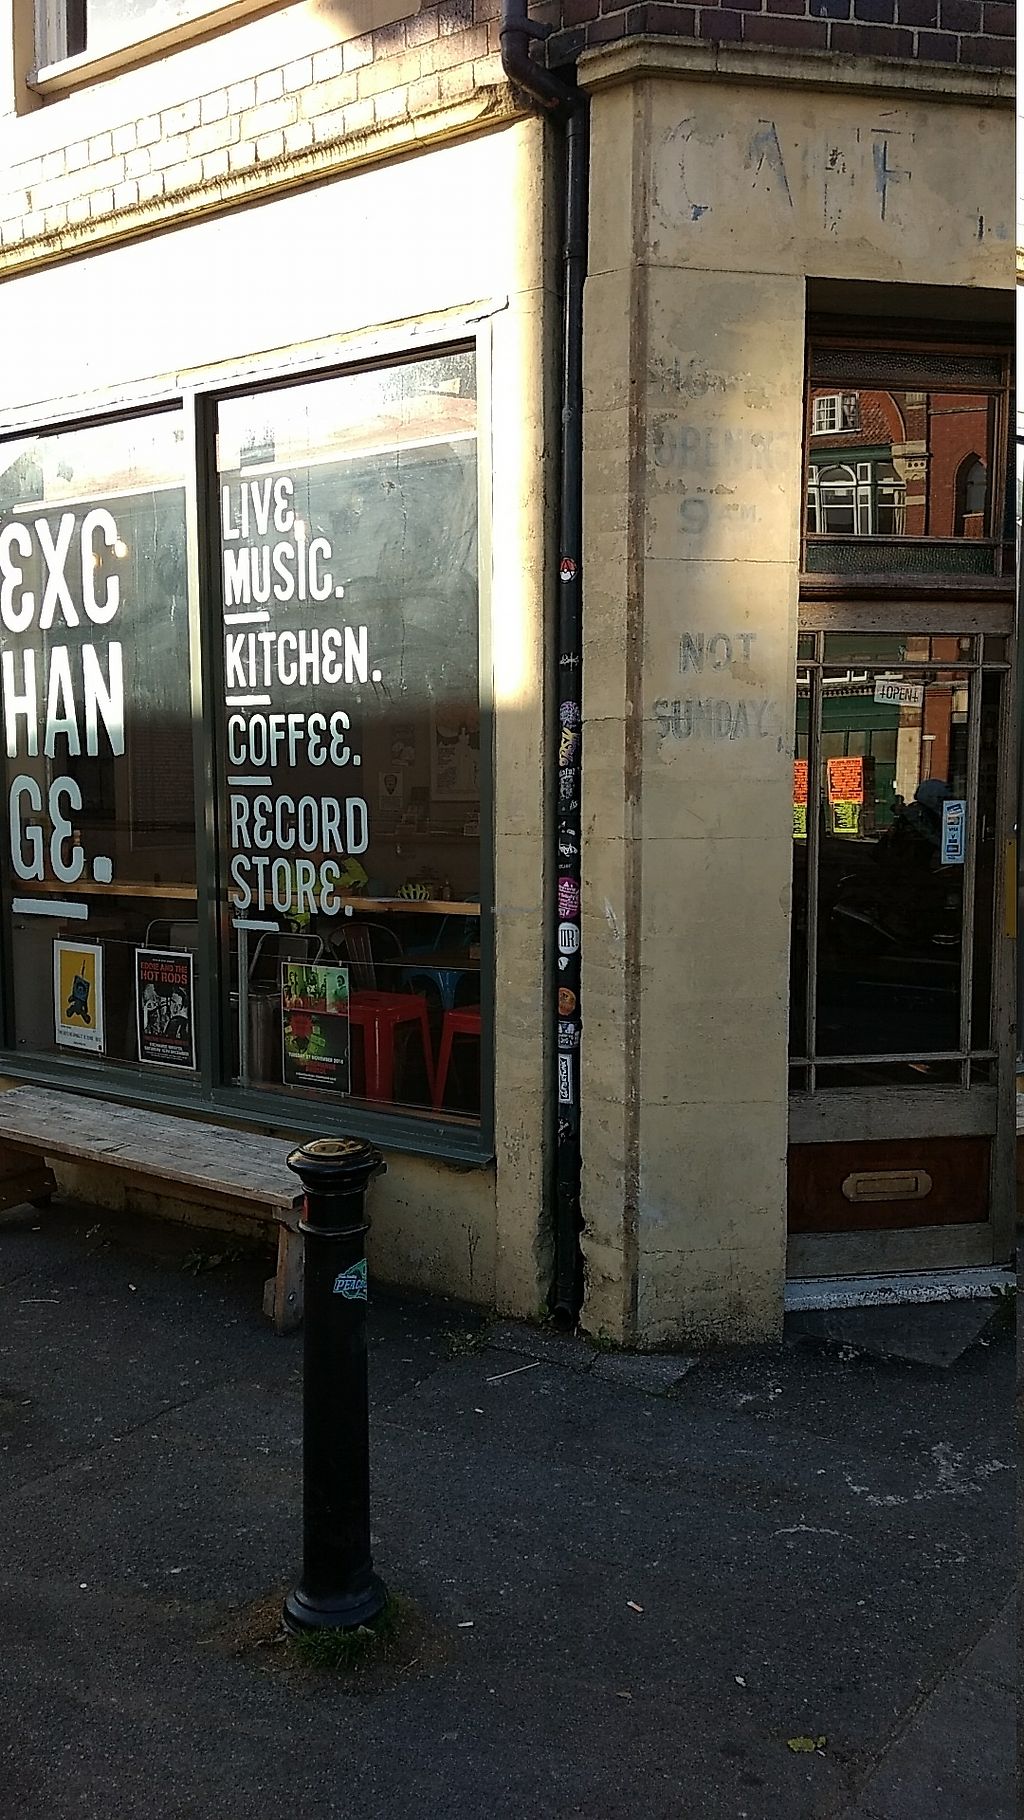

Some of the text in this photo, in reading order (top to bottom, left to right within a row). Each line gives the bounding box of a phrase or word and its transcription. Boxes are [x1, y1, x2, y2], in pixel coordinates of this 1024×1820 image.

[0, 508, 120, 633] EXC
[223, 536, 345, 607] MUSIC.
[225, 625, 382, 689] KITCHEN.
[679, 632, 757, 674] NOT
[2, 641, 126, 759] HAN
[886, 685, 912, 701] OPEN
[227, 710, 361, 767] COFFEE.
[9, 774, 113, 884] GE.
[230, 793, 369, 854] RECORD
[230, 853, 353, 917] STORE.
[140, 969, 188, 985] HOT RODS
[160, 963, 174, 972] AND
[175, 965, 188, 975] THE
